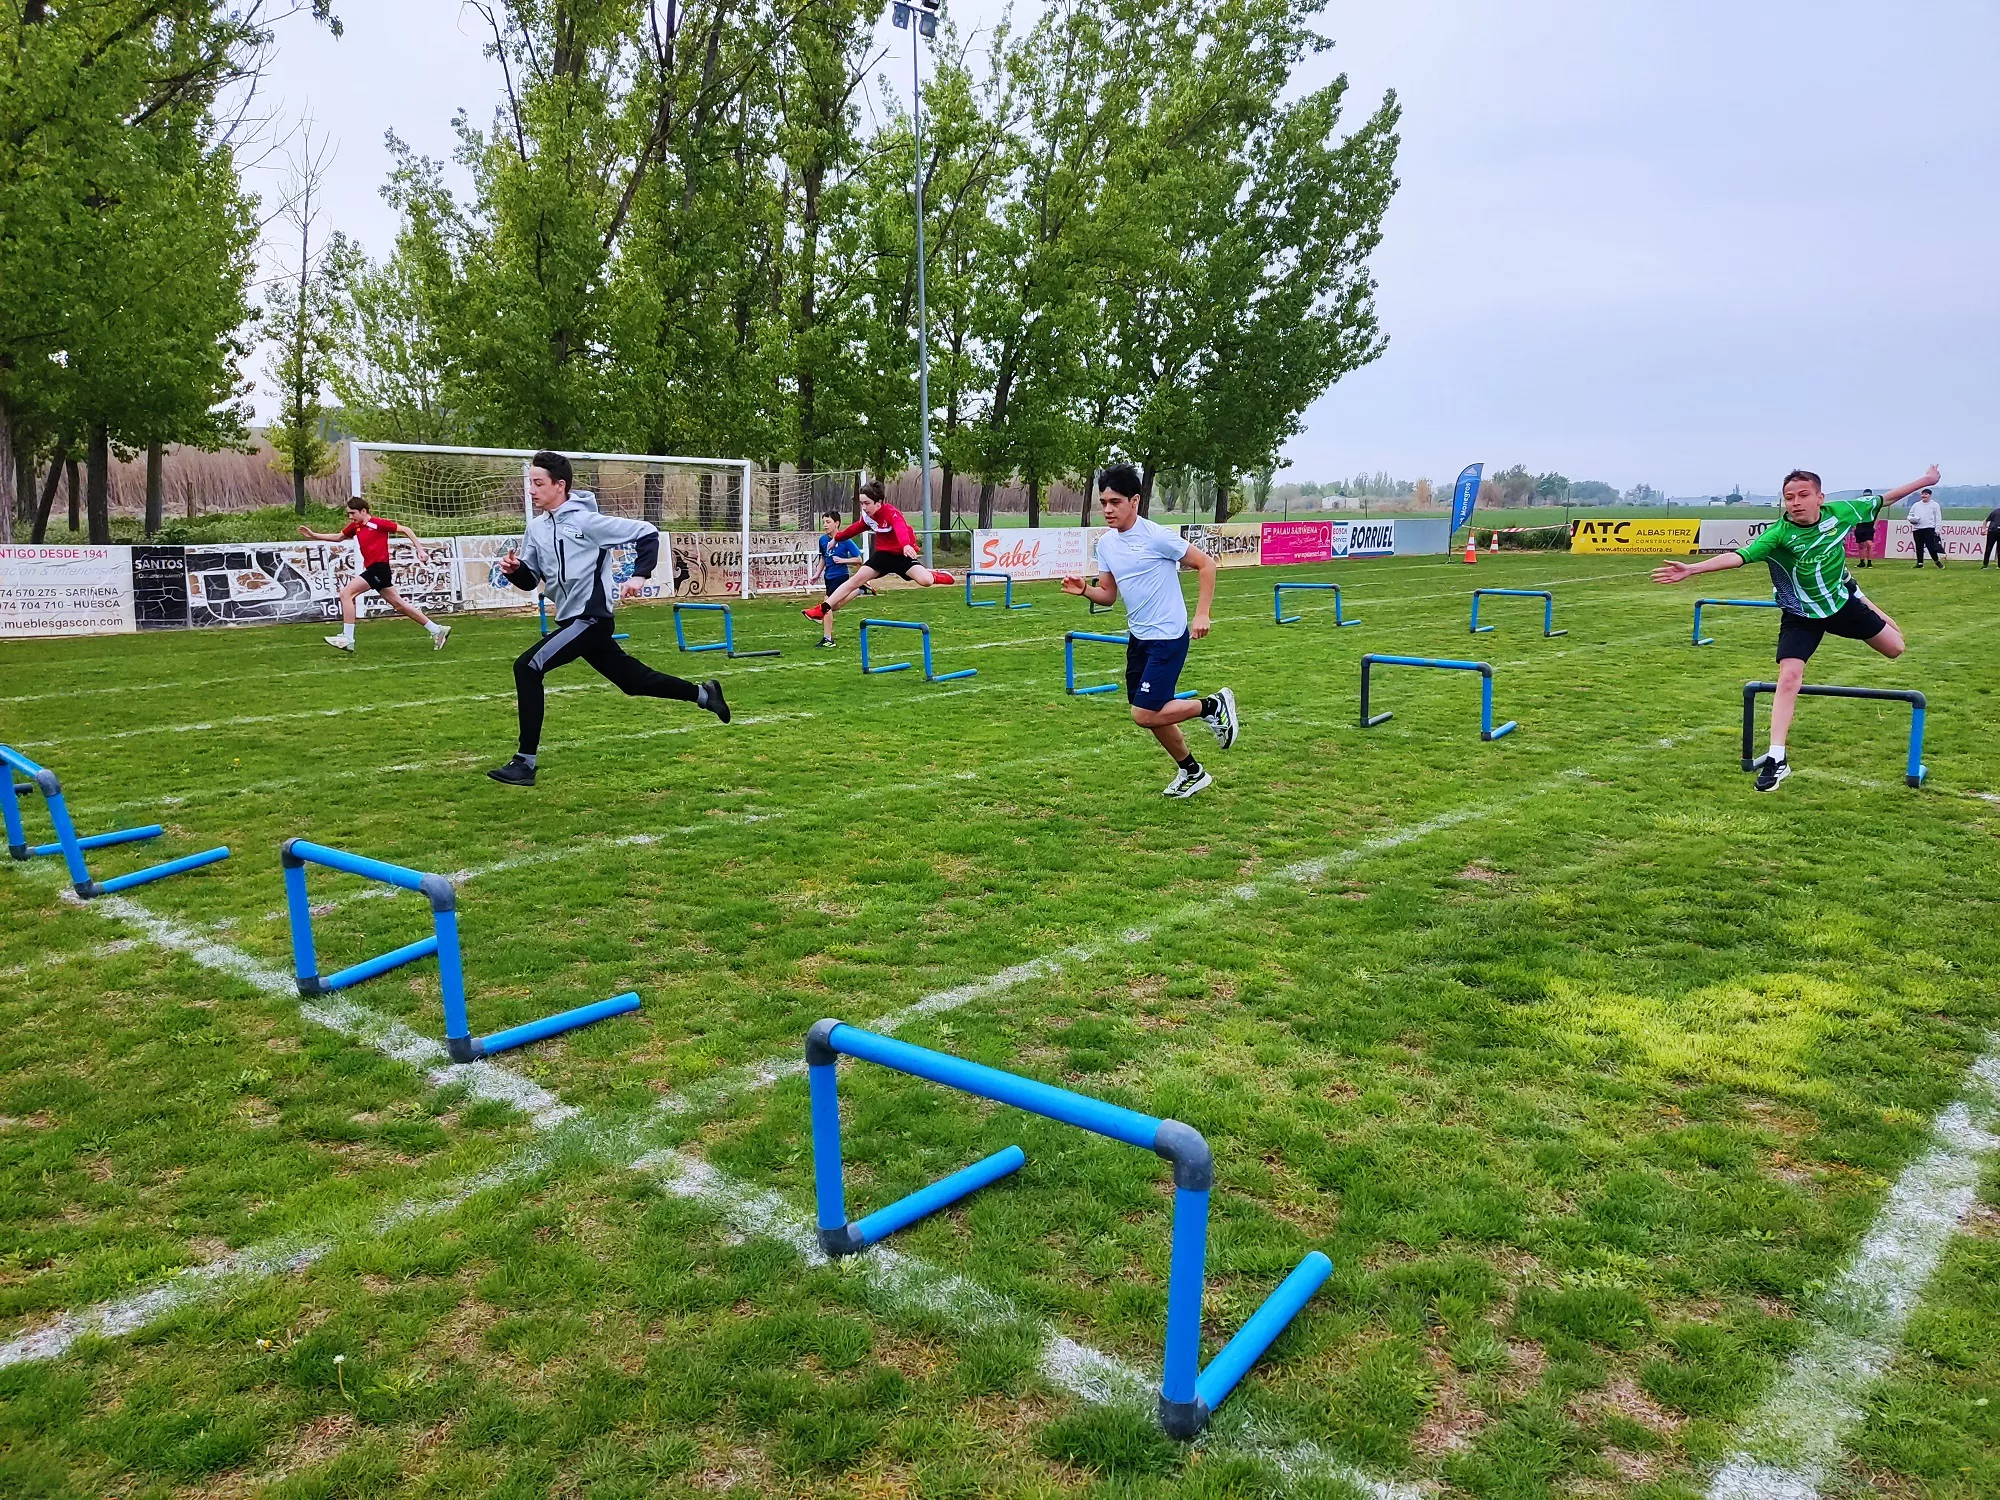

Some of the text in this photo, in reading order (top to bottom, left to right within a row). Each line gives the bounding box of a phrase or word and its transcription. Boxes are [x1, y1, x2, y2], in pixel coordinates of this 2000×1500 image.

[1350, 526, 1393, 549] BORRUEL
[1582, 521, 1631, 544] ATC
[752, 536, 790, 544] UNISEX
[1719, 538, 1741, 546] LA
[40, 548, 80, 559] DESDE
[83, 549, 108, 559] 1941
[979, 538, 1040, 569] Sabel
[134, 559, 184, 570] SANTOS
[40, 567, 49, 576] &
[37, 588, 57, 597] 275
[65, 586, 119, 597] SARIÑENA
[725, 581, 742, 592] 97
[20, 601, 41, 610] 704
[44, 601, 64, 609] 710
[73, 599, 121, 609] HUESCA
